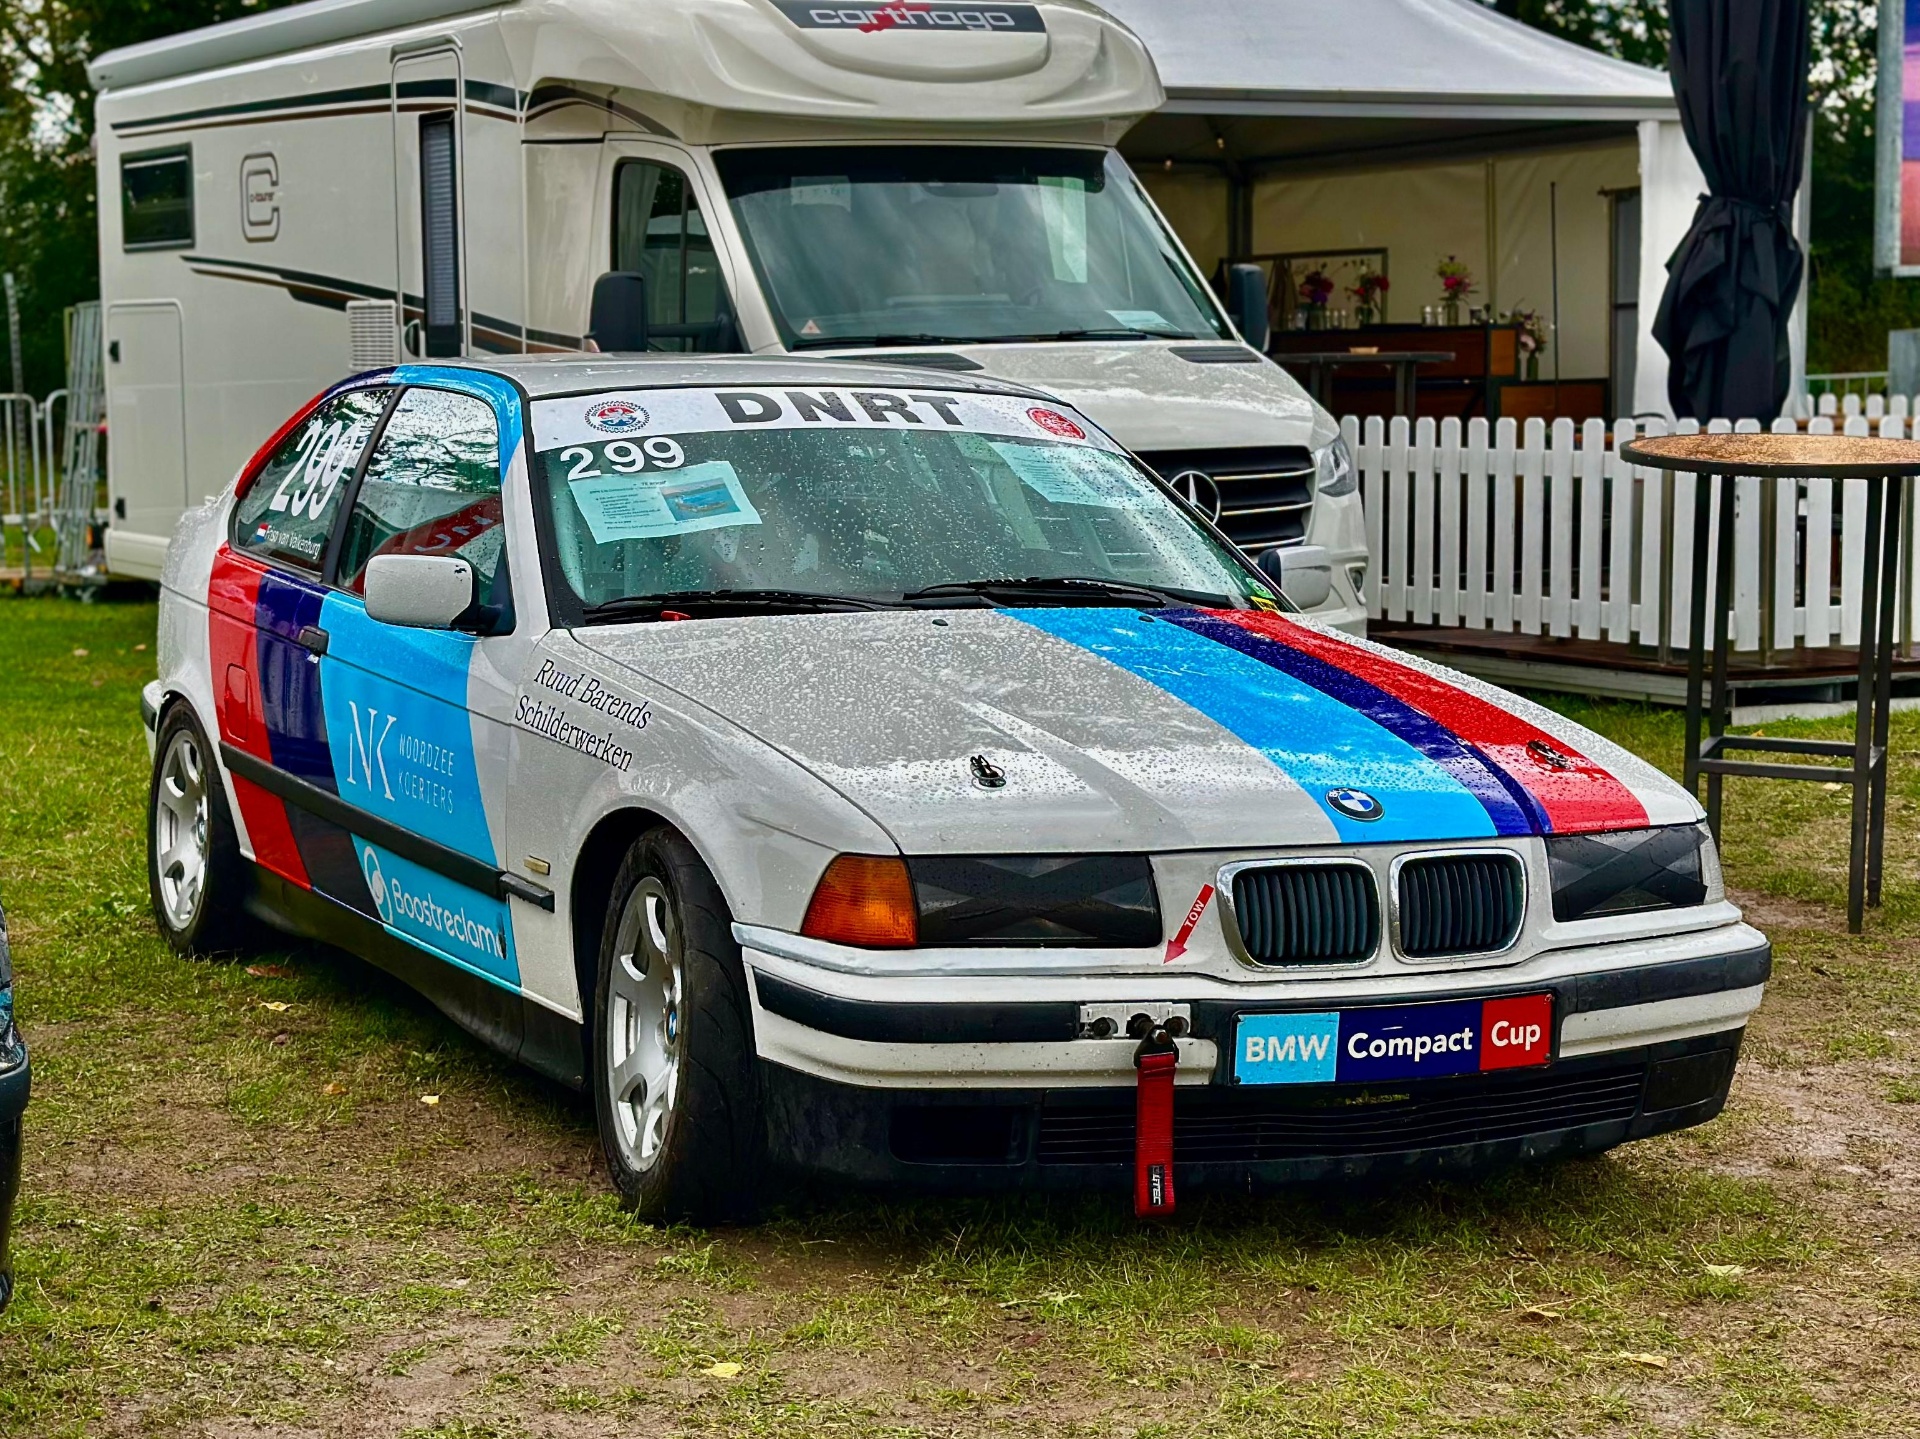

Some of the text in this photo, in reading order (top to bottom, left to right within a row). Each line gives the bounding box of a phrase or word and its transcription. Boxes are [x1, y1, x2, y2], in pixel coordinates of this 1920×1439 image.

[809, 8, 1016, 32] carthago
[714, 391, 965, 427] DNRT
[268, 417, 363, 521] 299
[560, 437, 684, 481] 299
[533, 658, 652, 730] Ruud Barends
[346, 700, 398, 802] NK
[400, 733, 455, 777] NOORDZEE
[514, 694, 633, 772] Schilderwerken
[398, 768, 454, 814] KOERIERS
[391, 878, 506, 958] Boostreclam
[1183, 899, 1206, 929] TOW
[1245, 1020, 1542, 1063] BMW Compact Cup
